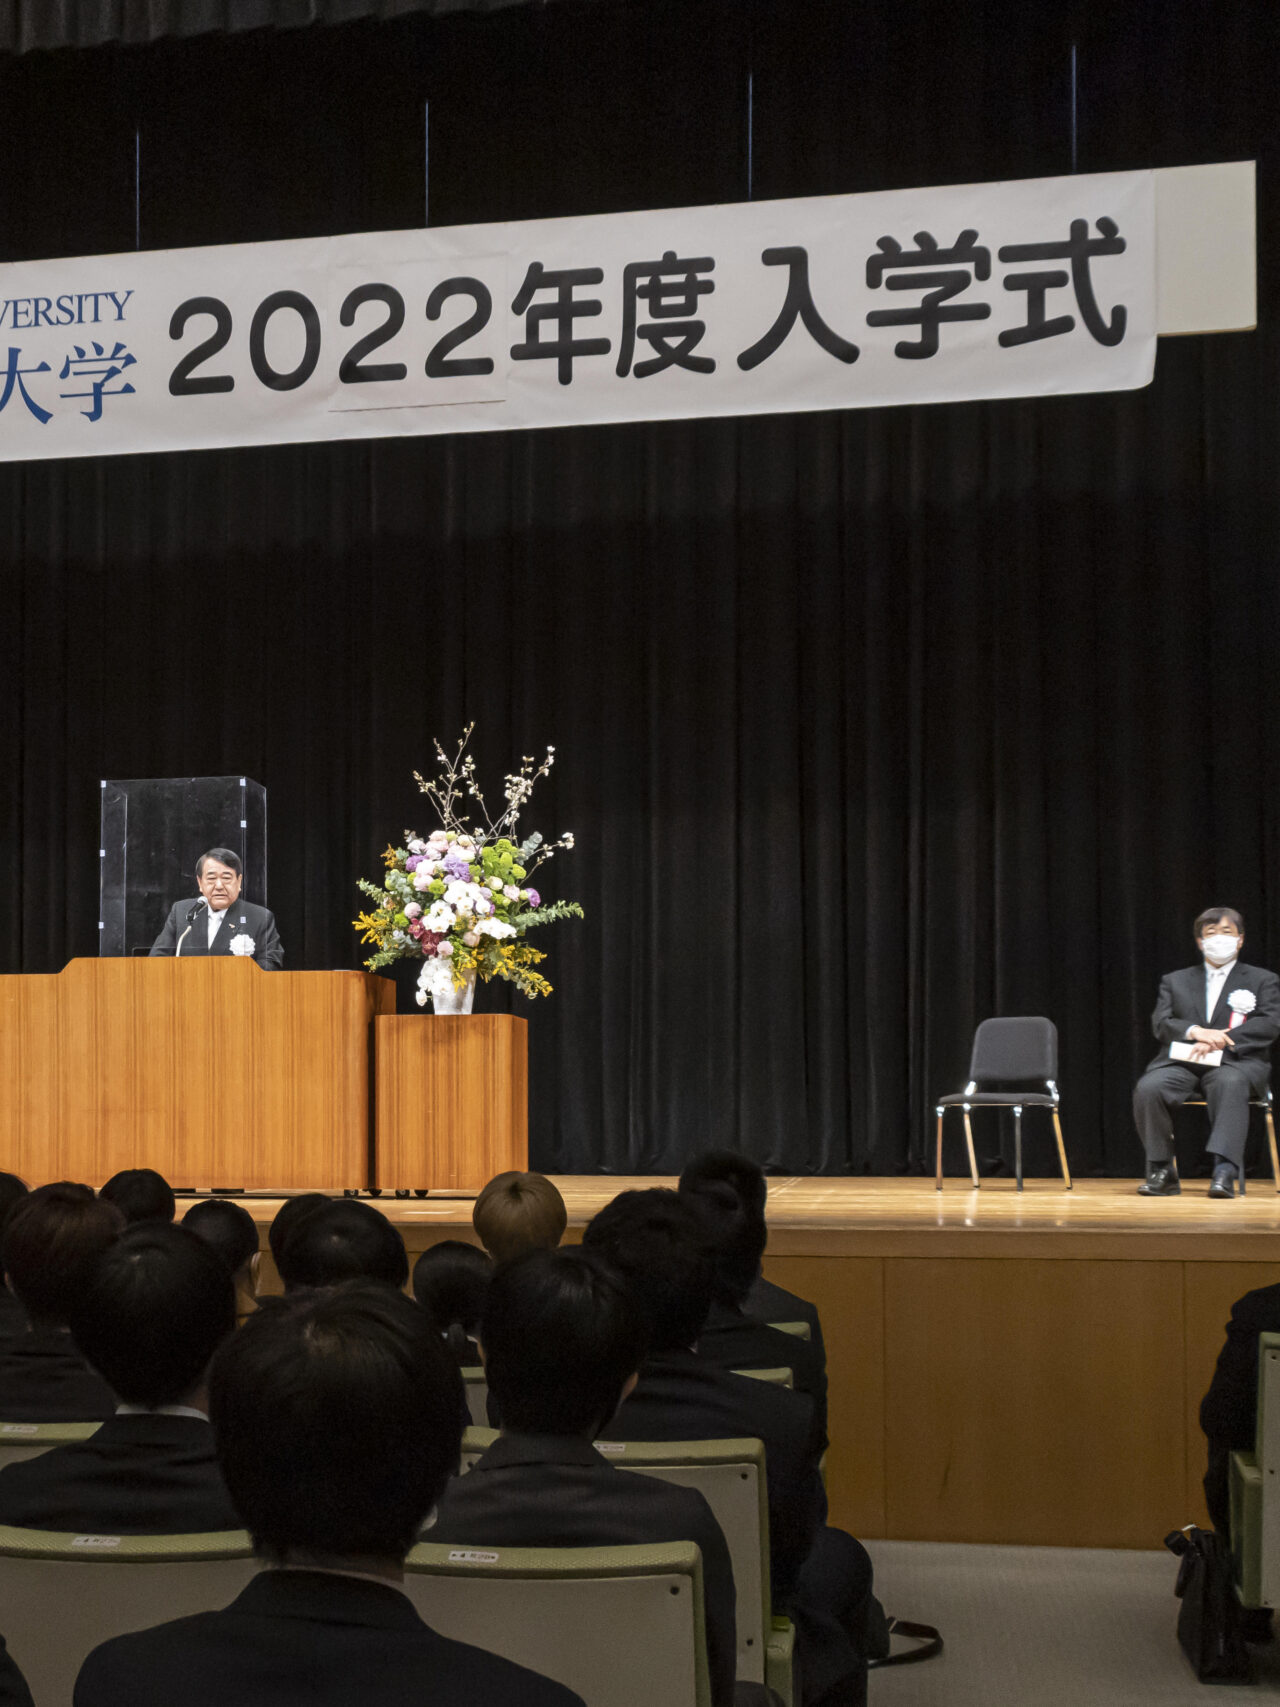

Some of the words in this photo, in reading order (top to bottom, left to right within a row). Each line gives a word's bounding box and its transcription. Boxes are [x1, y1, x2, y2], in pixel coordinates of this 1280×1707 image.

[166, 214, 1130, 398] 2022年度入学式
